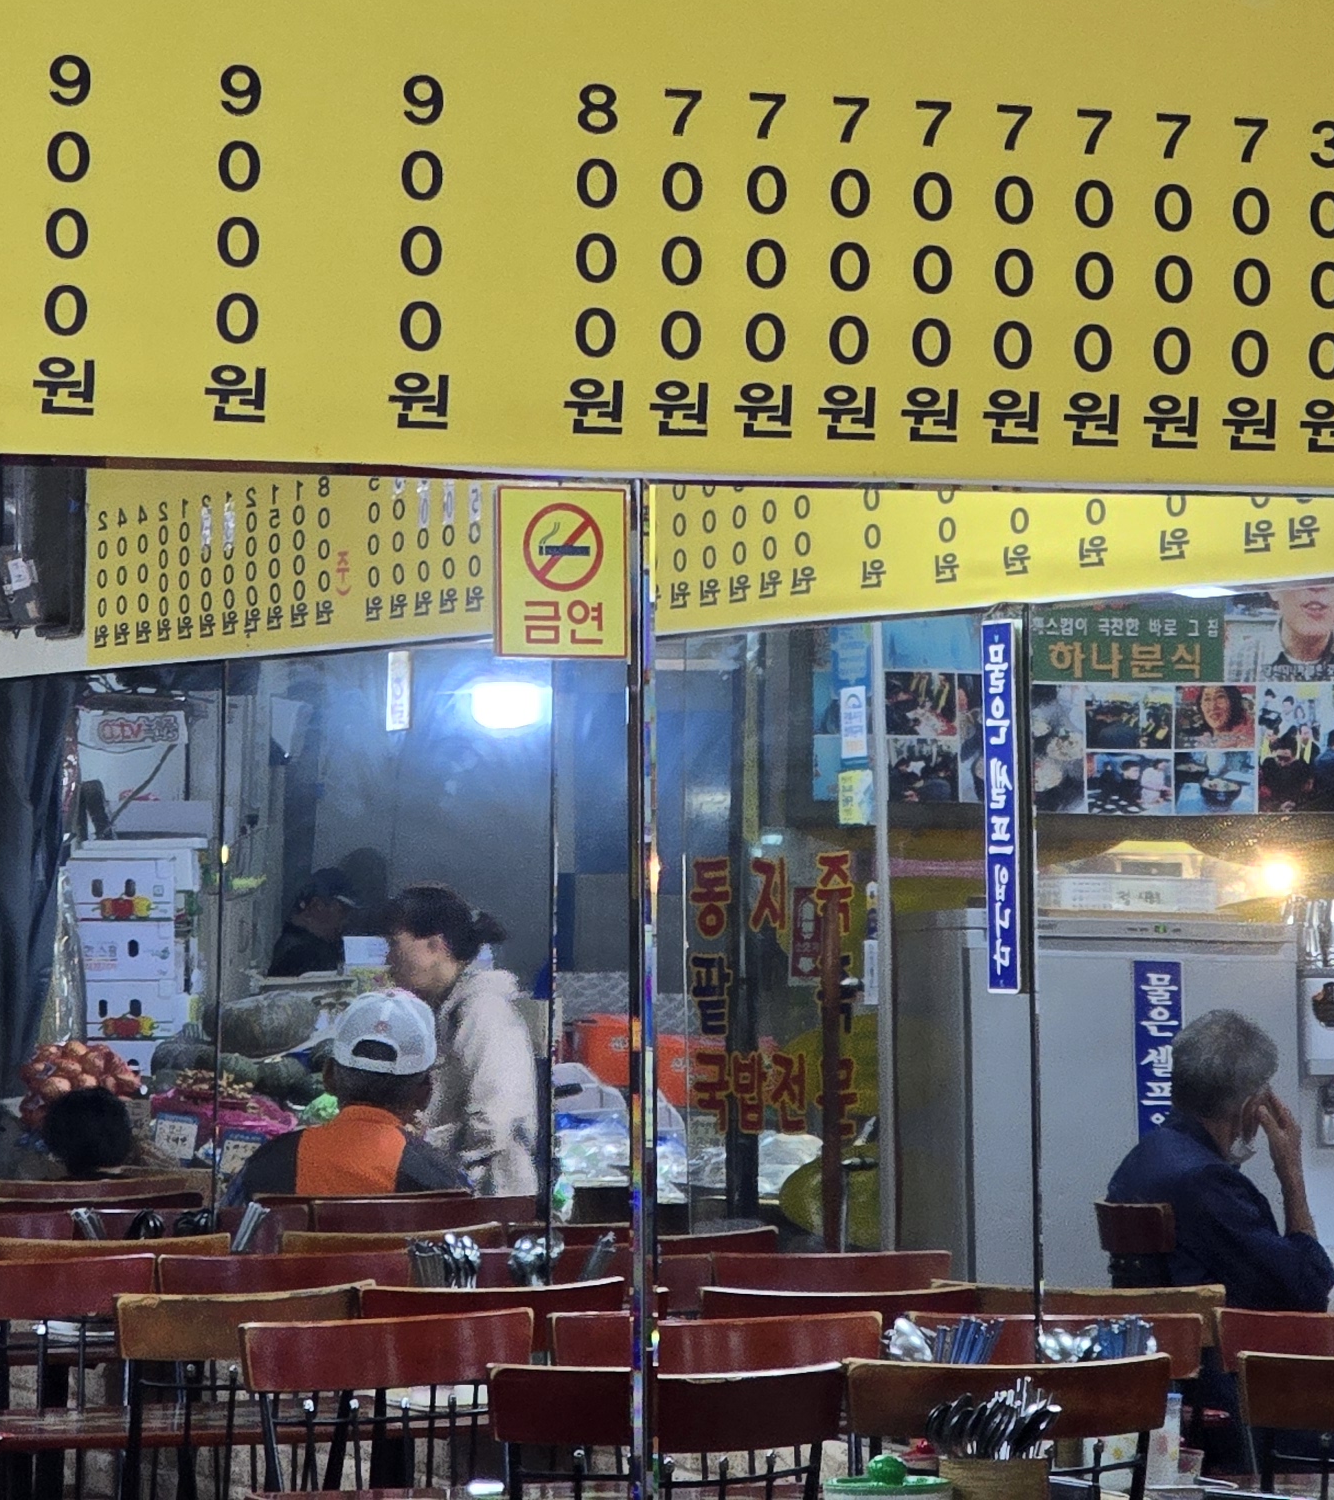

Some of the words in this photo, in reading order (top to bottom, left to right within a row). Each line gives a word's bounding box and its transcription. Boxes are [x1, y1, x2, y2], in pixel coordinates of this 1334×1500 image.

[33, 54, 95, 416] 9000원
[205, 64, 266, 423] 9000원
[388, 75, 449, 430] 9000원
[564, 83, 623, 435] 8000원
[649, 88, 708, 437] 7000원
[734, 92, 792, 438] 7000원
[818, 96, 876, 441] 7000원
[901, 100, 958, 442] 7000원
[983, 104, 1039, 445] 7000원
[1064, 108, 1119, 447] 7000원
[1143, 113, 1198, 449] 7000원
[1222, 117, 1276, 451] 7000원
[524, 600, 604, 645] 금연
[1048, 641, 1202, 679] 하나분식
